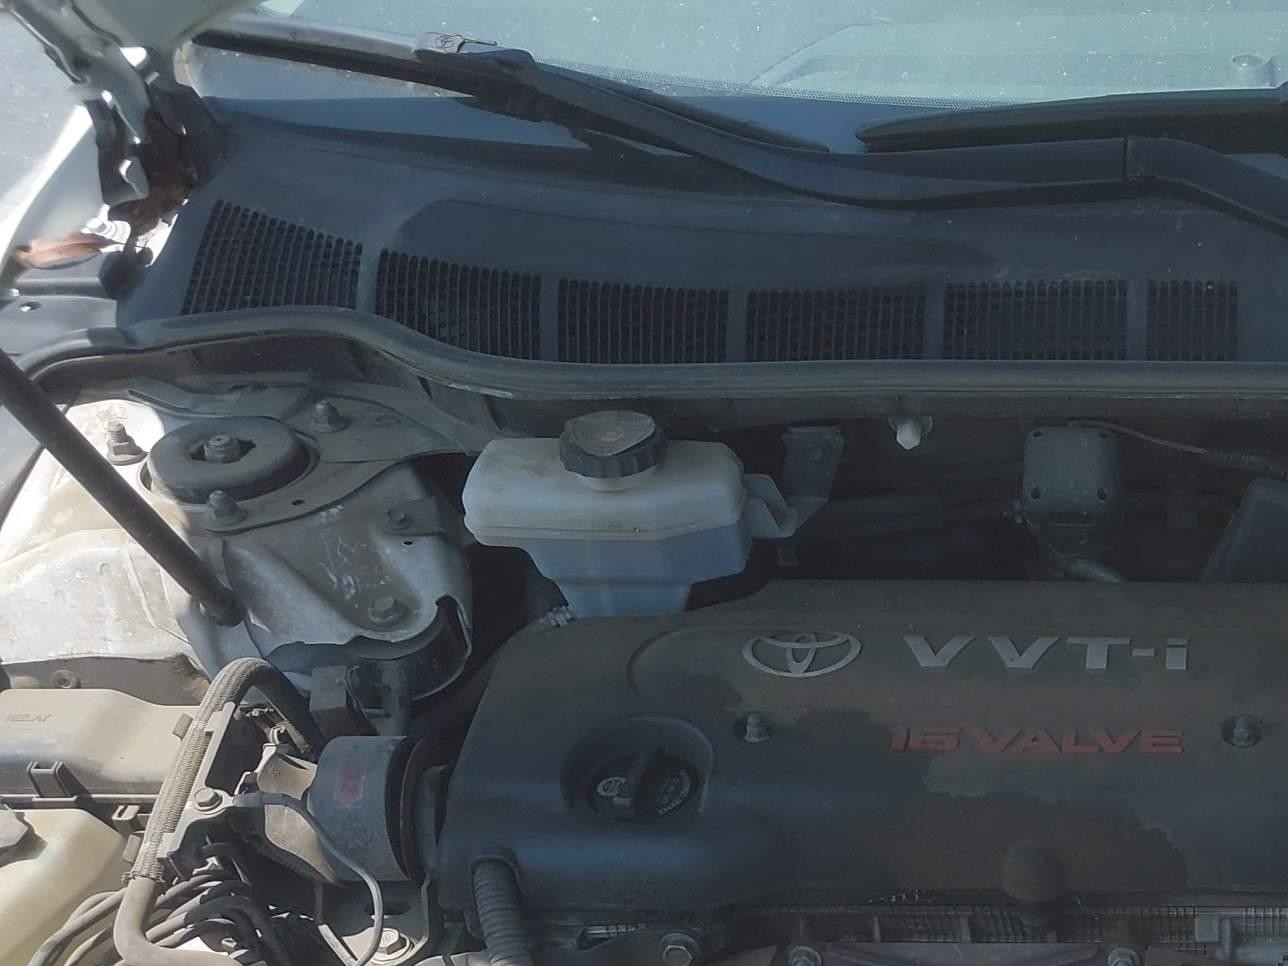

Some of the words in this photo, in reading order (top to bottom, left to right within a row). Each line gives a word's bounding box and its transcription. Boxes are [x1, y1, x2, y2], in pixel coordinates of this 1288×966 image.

[902, 636, 1188, 670] VVT-i
[890, 728, 961, 752] 16
[973, 728, 1185, 752] VALVE
